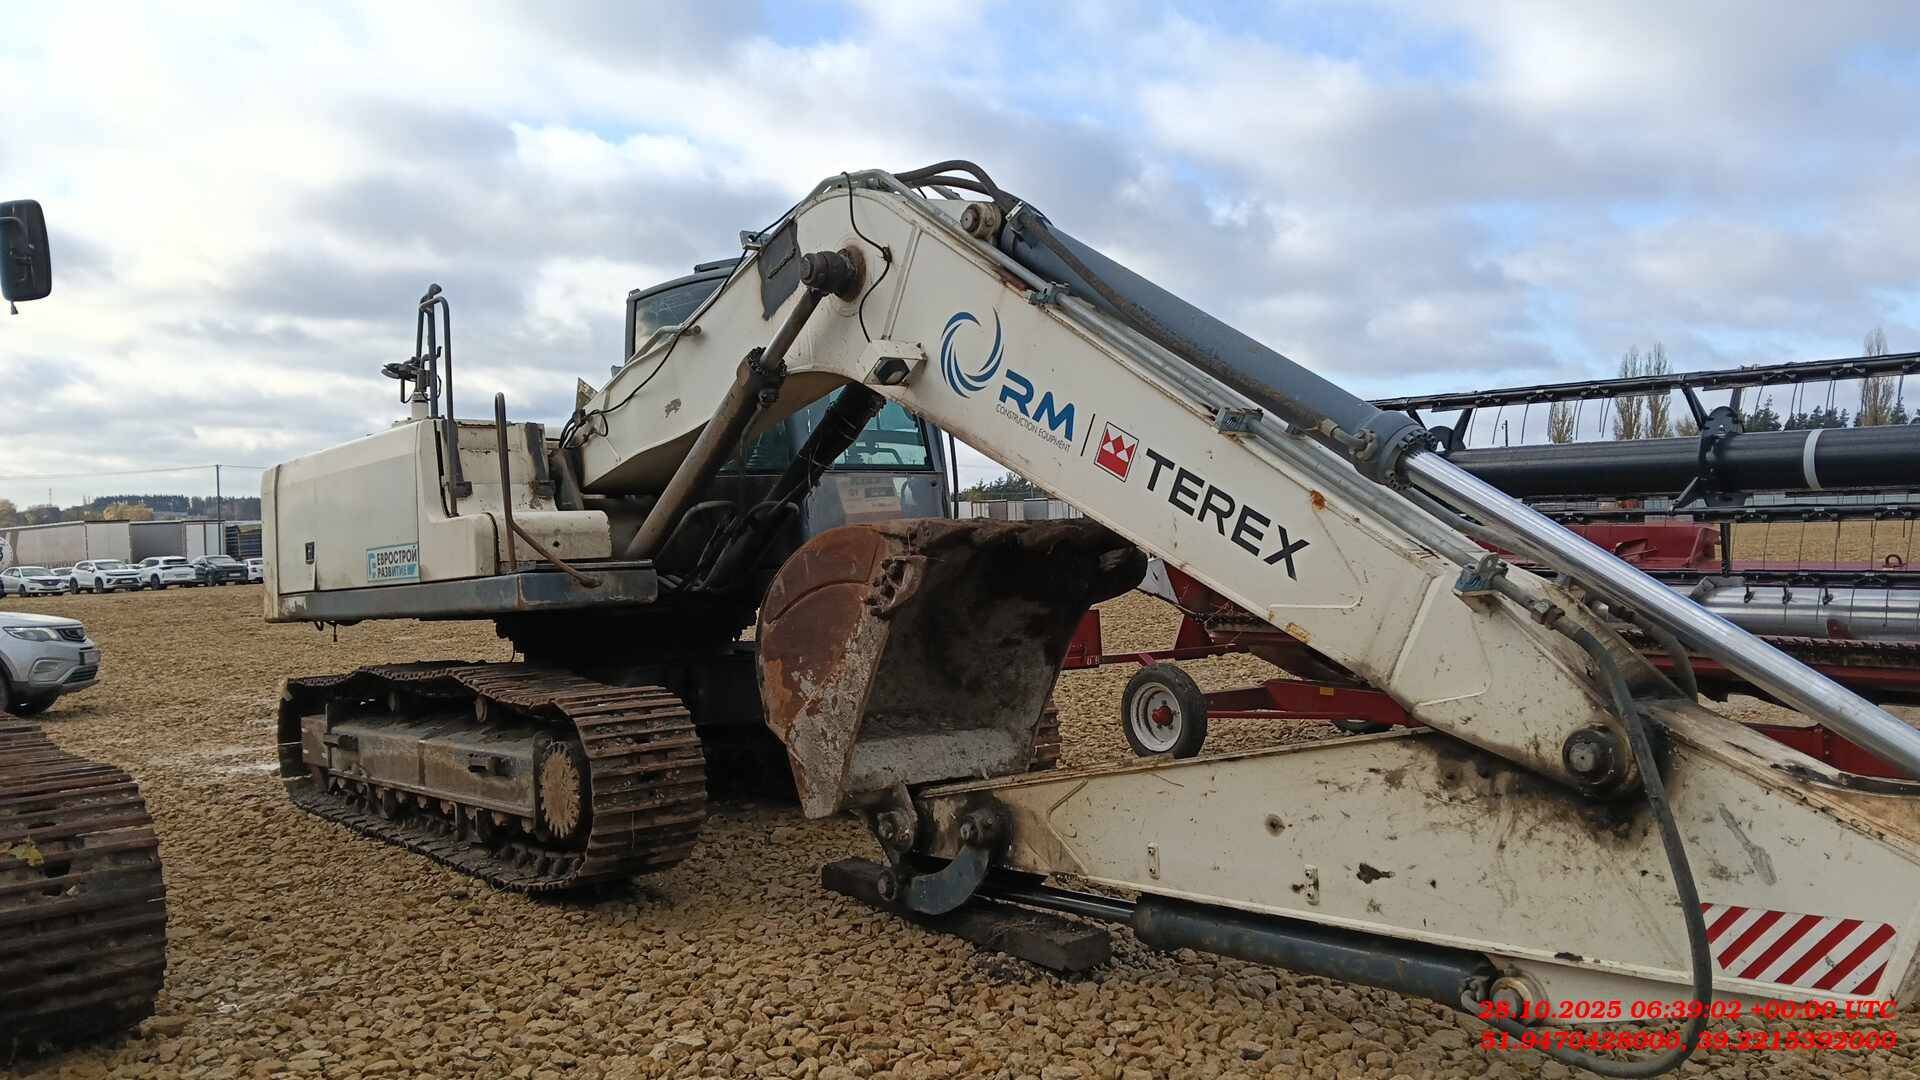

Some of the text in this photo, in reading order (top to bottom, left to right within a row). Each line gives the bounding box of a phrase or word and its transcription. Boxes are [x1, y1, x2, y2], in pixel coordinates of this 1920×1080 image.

[999, 369, 1075, 442] RM
[1146, 448, 1310, 581] TEREX
[376, 545, 417, 566] ЕВРОСТРОЙ
